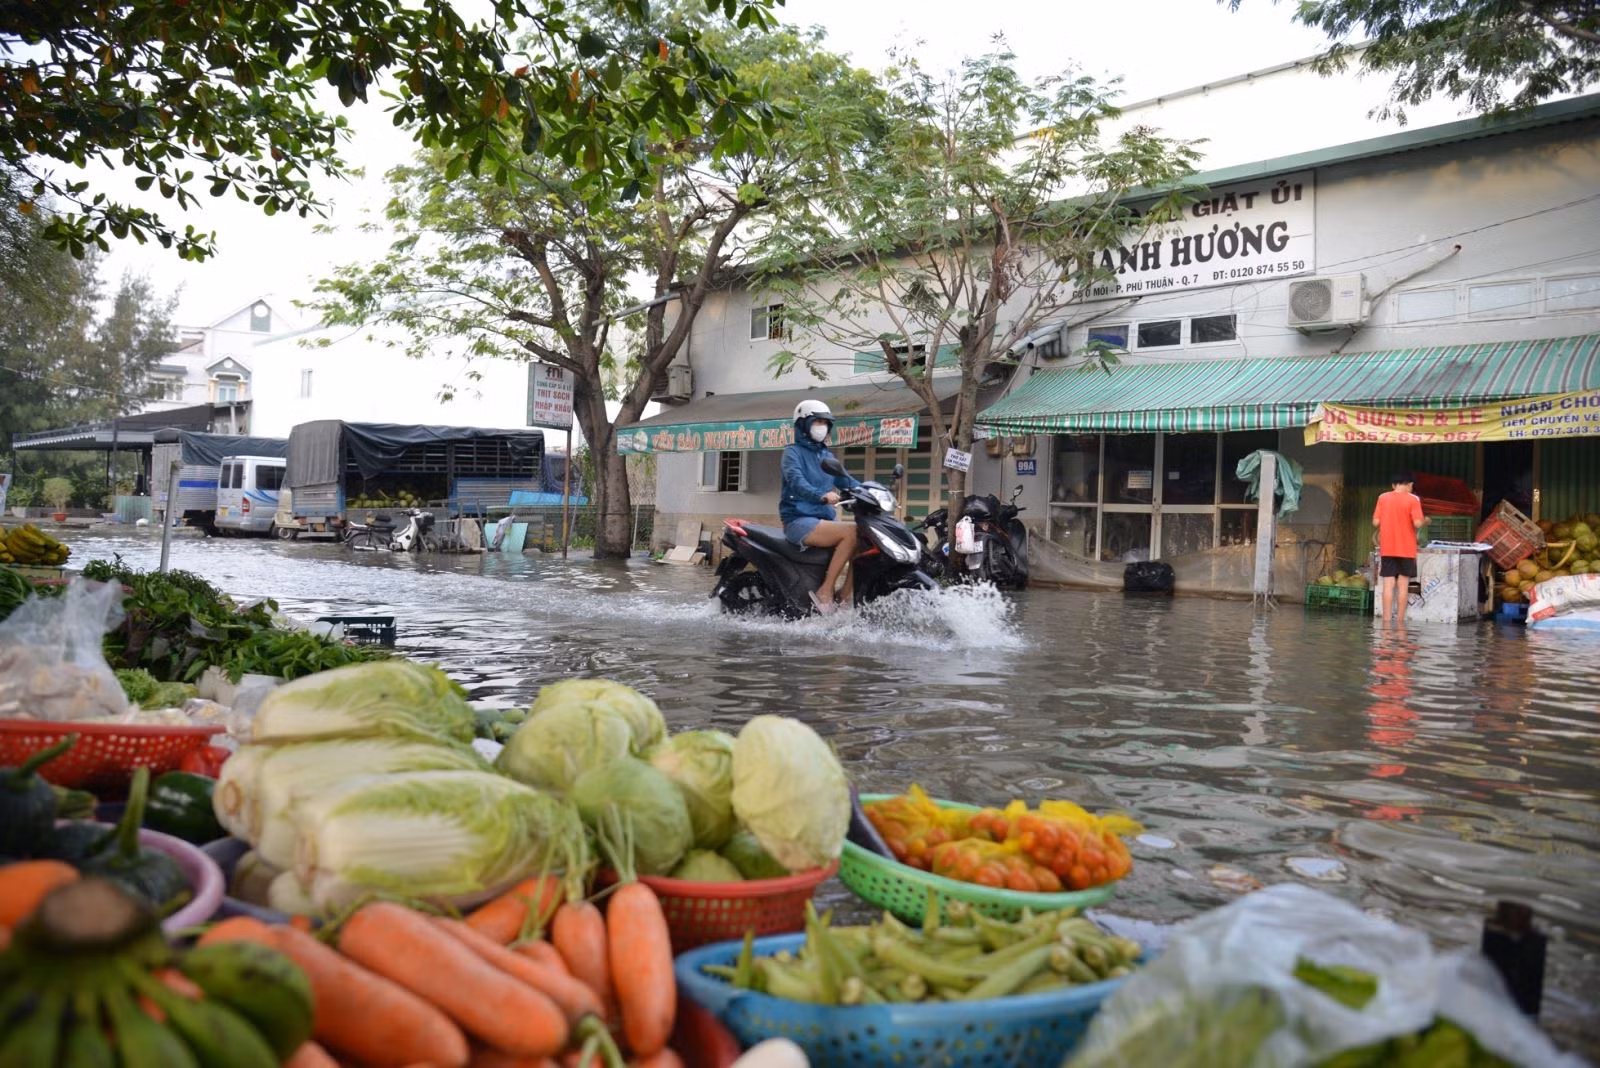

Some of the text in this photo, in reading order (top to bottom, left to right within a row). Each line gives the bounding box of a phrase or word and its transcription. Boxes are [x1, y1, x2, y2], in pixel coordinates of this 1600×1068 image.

[1192, 191, 1260, 218] GIẶT
[1271, 180, 1303, 205] ỦI
[1170, 221, 1290, 267] HƯƠNG
[1146, 277, 1174, 290] THUẬN
[1193, 274, 1199, 284] 7
[1230, 266, 1254, 278] 0120
[1256, 264, 1274, 275] 874
[1277, 262, 1290, 272] 55
[1292, 260, 1305, 270] 50
[1433, 411, 1448, 426] &
[703, 424, 756, 449] NGUYÊN
[1018, 460, 1035, 471] 99A
